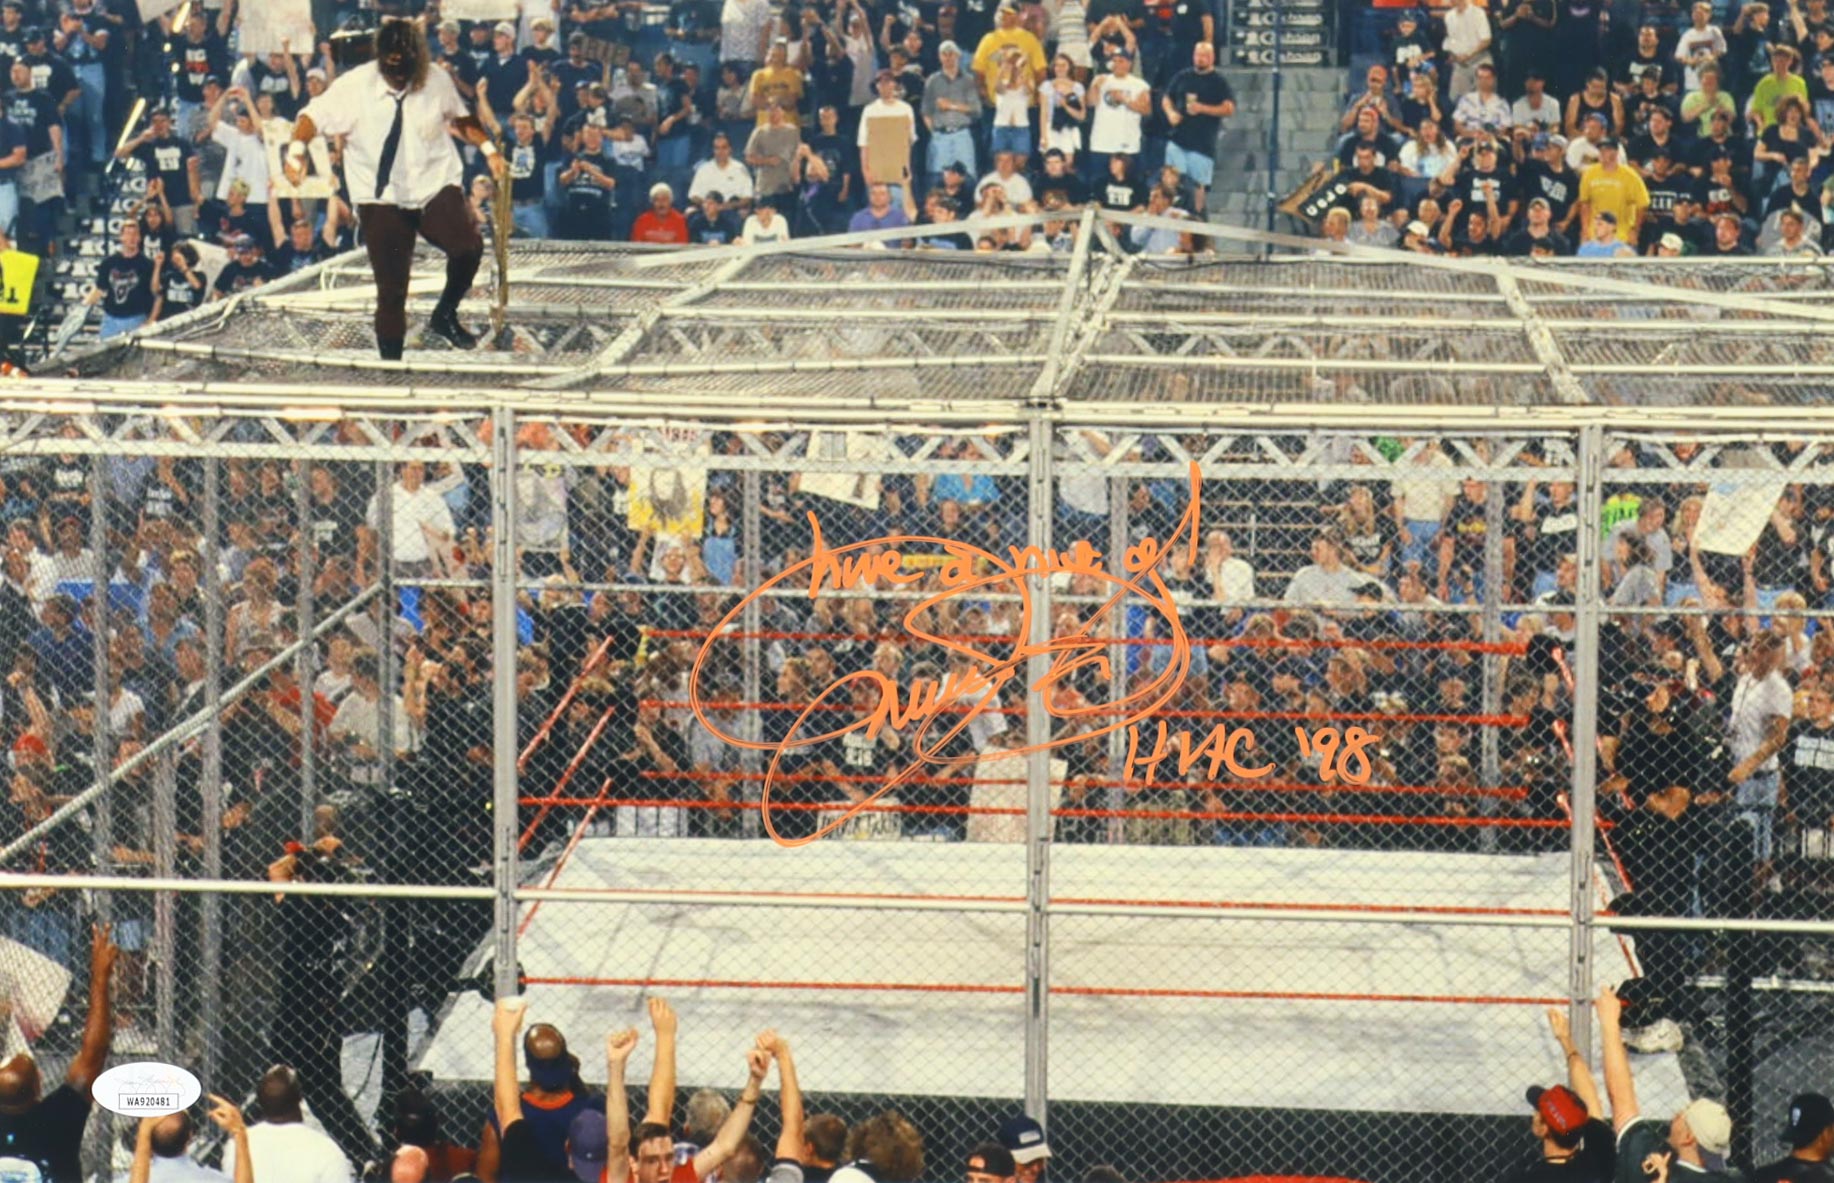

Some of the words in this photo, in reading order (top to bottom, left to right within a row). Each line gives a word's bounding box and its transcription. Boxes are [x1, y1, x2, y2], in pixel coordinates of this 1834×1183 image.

[940, 544, 978, 586] a
[1295, 726, 1381, 785] '98
[126, 1096, 171, 1107] WA920481
